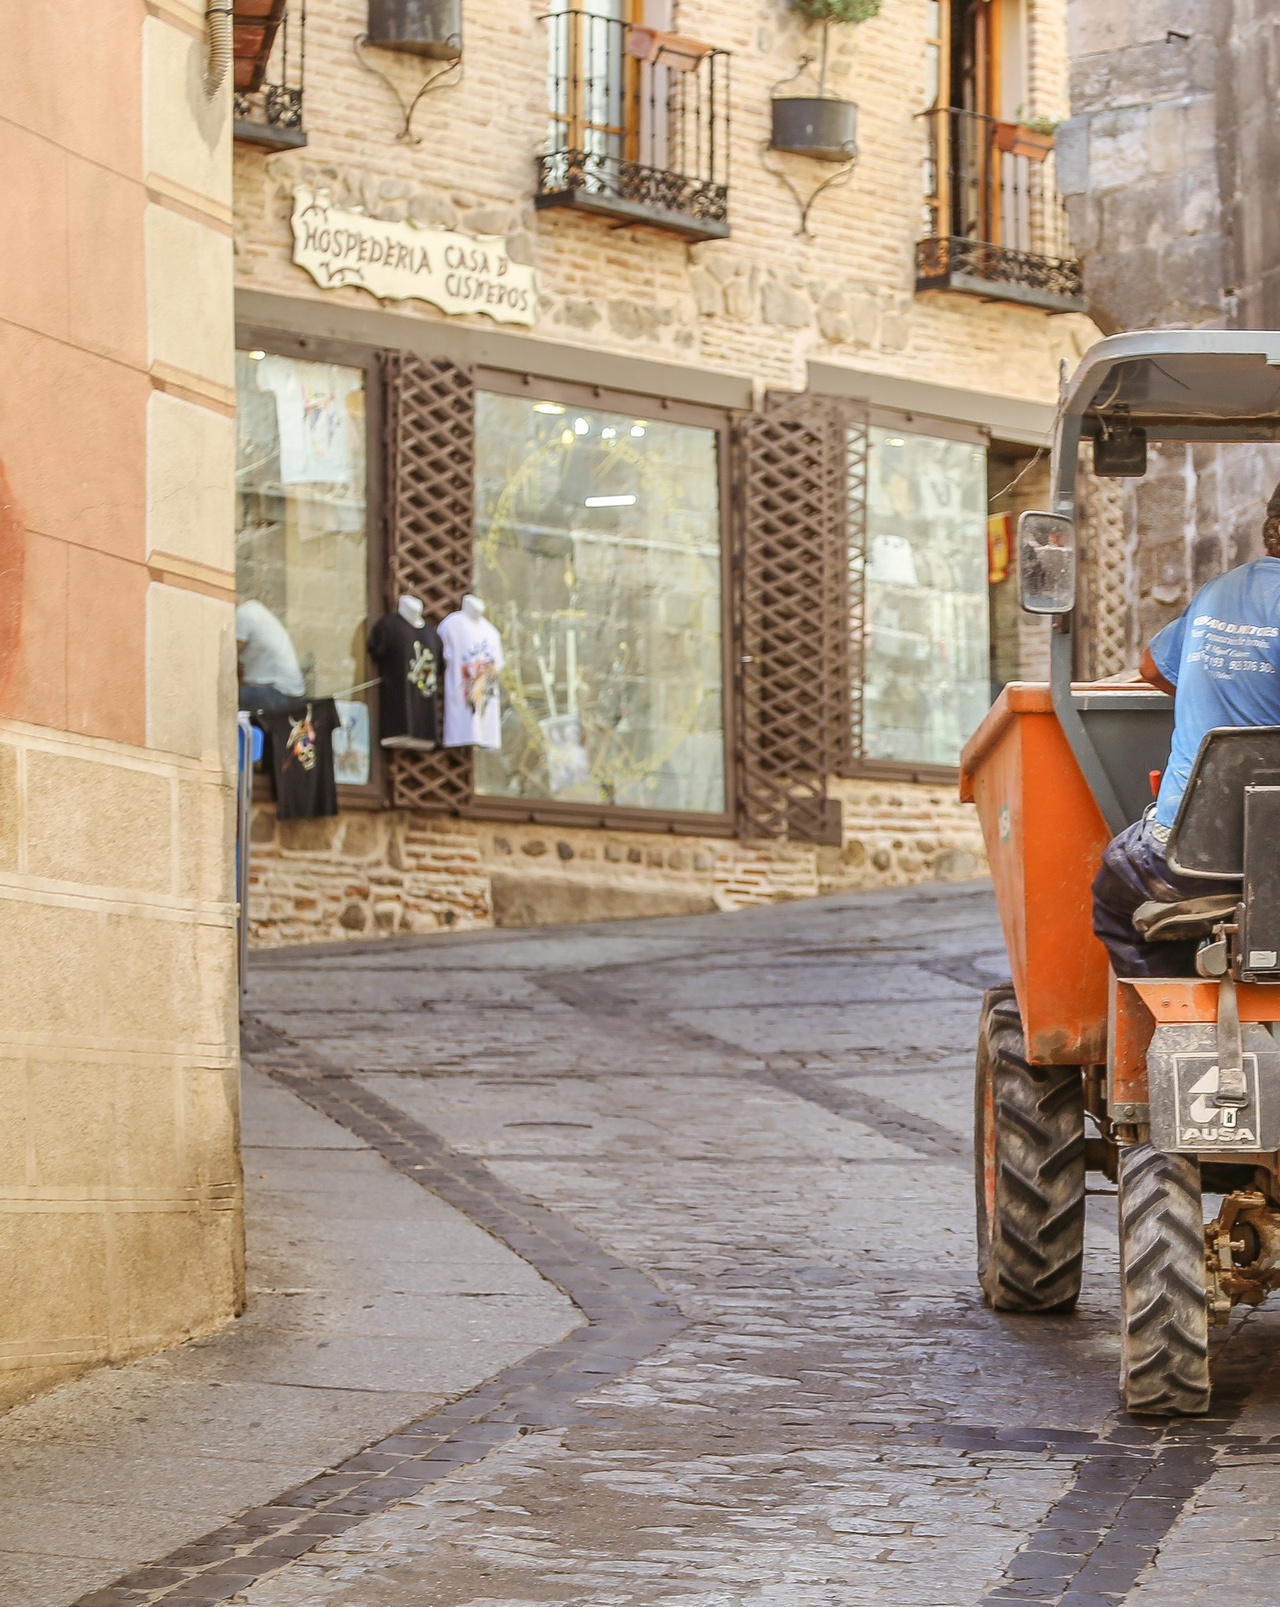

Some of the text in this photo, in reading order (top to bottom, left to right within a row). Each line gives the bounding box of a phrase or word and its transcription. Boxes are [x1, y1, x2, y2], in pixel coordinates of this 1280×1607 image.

[303, 221, 432, 275] HOSPEDERIA
[445, 245, 489, 275] CASA
[445, 274, 530, 312] CISNEROS
[1182, 1128, 1255, 1141] AUSA
